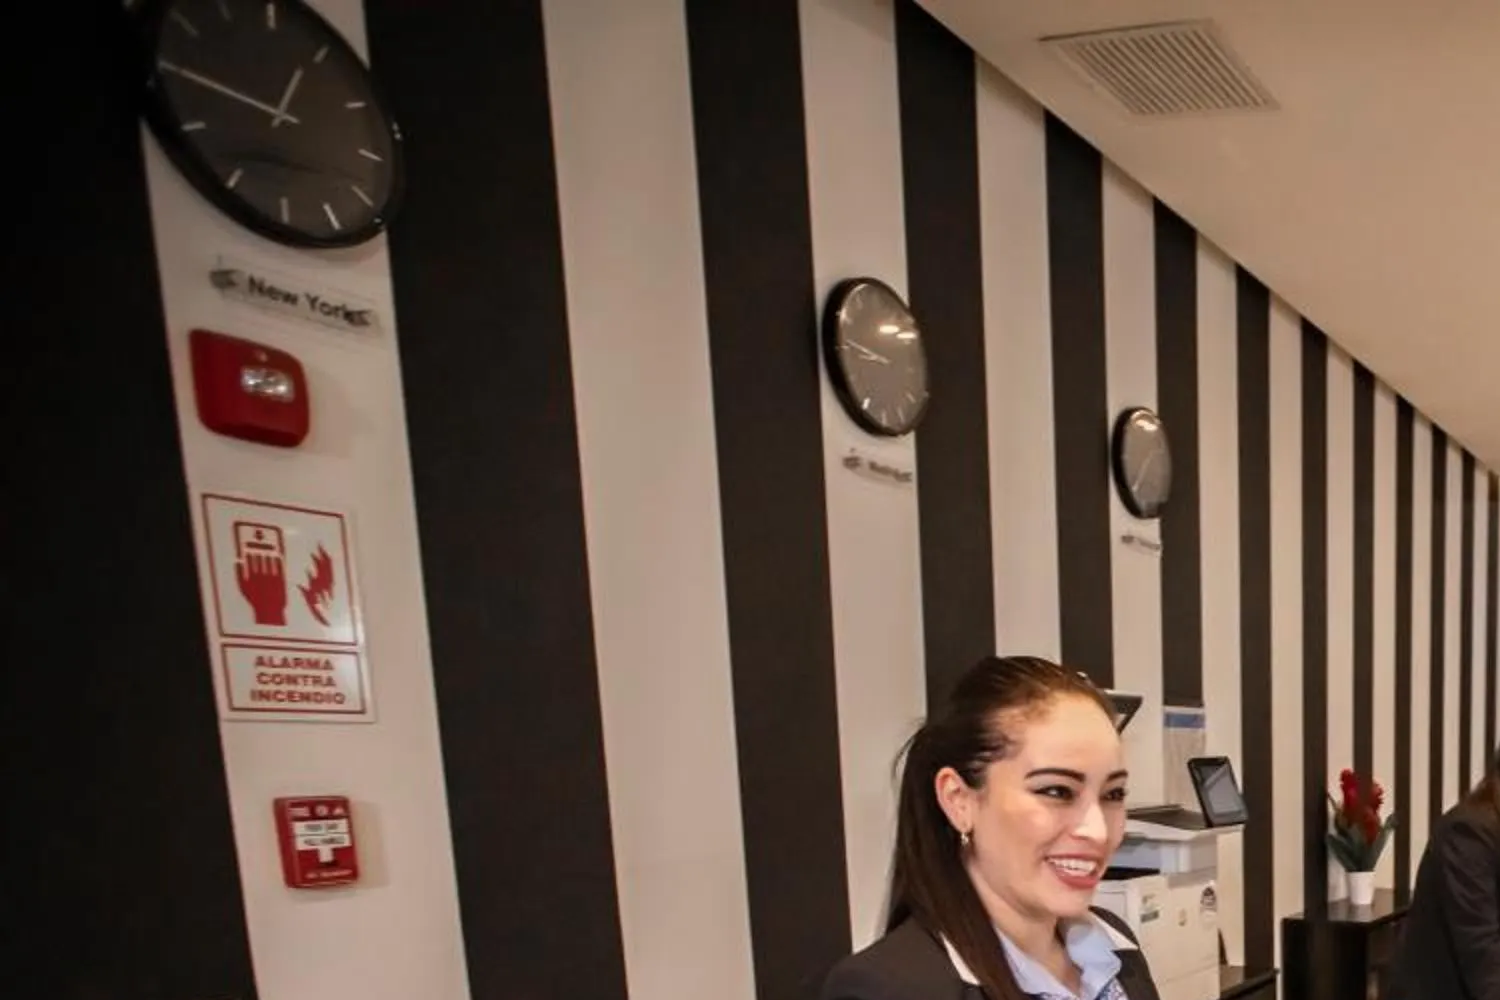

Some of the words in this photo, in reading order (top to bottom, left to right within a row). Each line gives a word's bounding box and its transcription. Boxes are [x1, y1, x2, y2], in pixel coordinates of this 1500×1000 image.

[248, 274, 299, 307] New
[254, 655, 335, 670] ALARMA
[256, 672, 337, 687] CONTRA
[249, 689, 346, 705] INCENDIO
